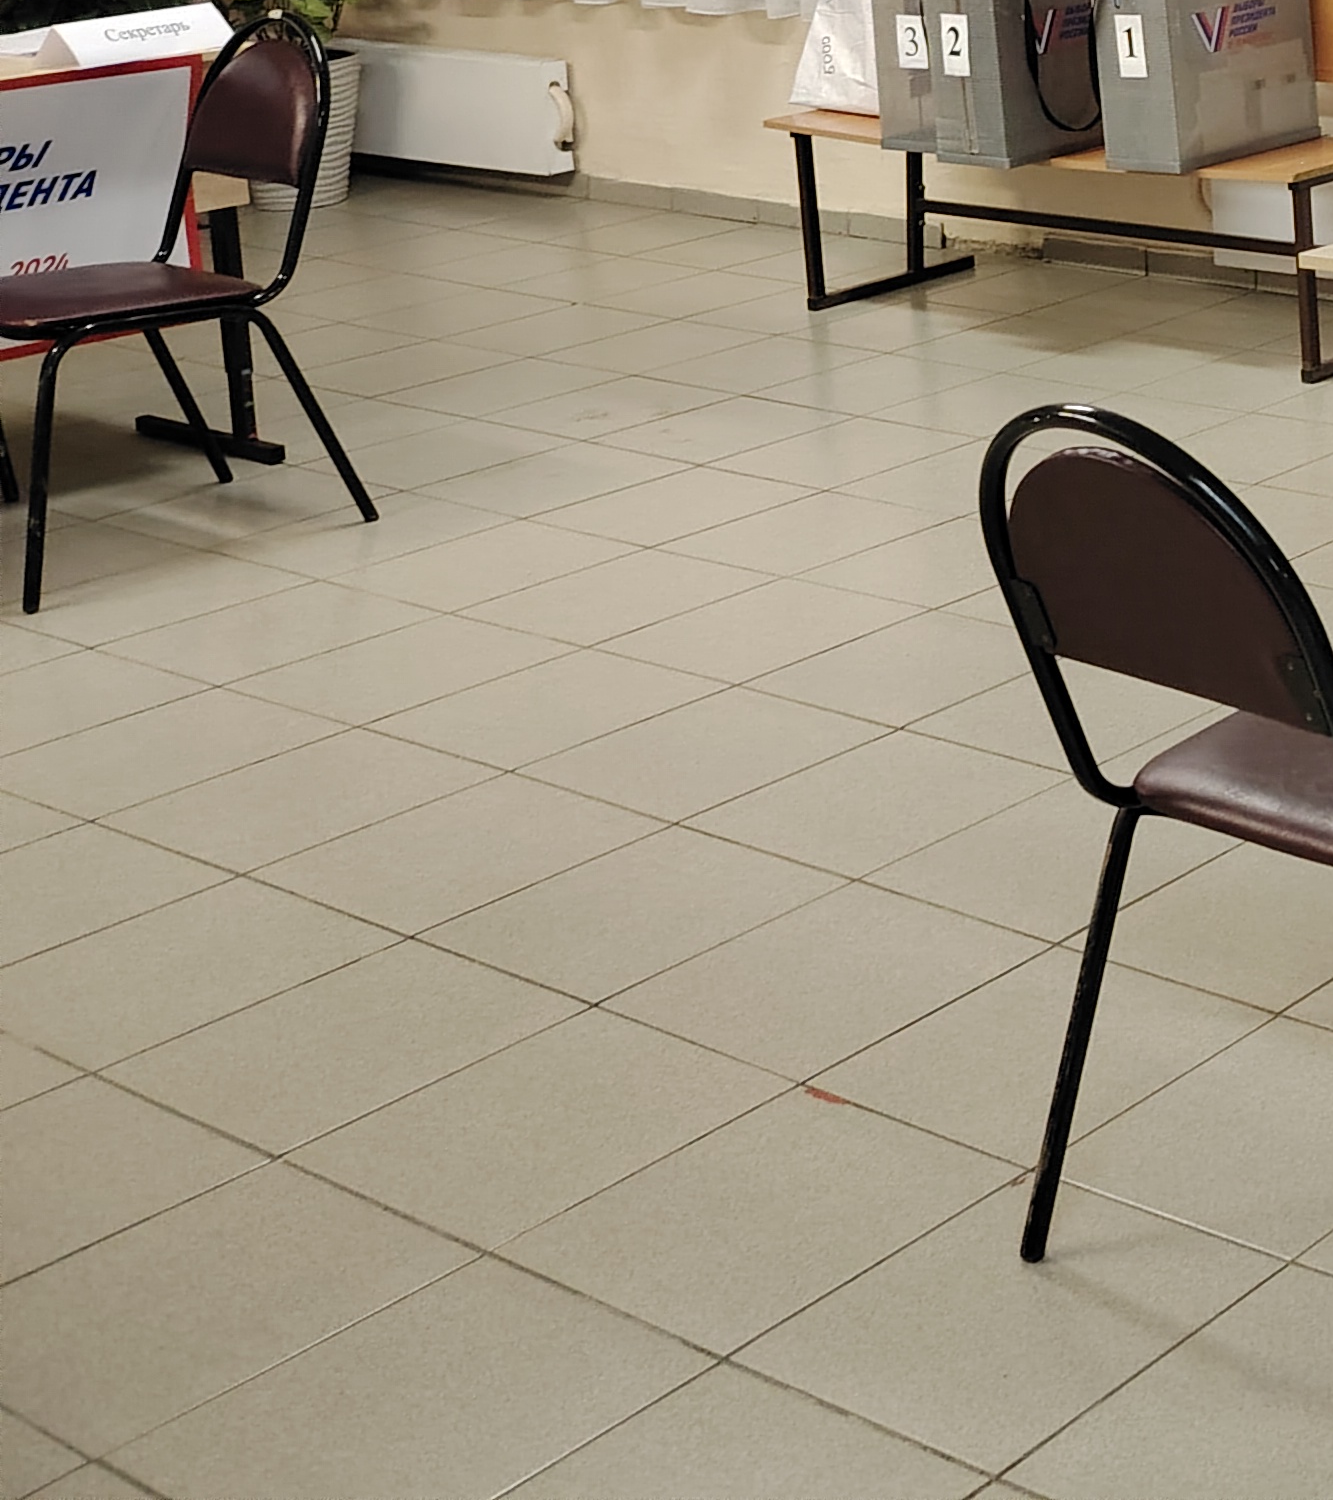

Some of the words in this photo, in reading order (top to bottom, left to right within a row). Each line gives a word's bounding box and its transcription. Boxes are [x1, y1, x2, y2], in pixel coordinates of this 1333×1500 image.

[104, 19, 191, 43] Секретарь
[904, 26, 919, 57] 3
[947, 26, 962, 57] 2
[1122, 27, 1138, 59] 1
